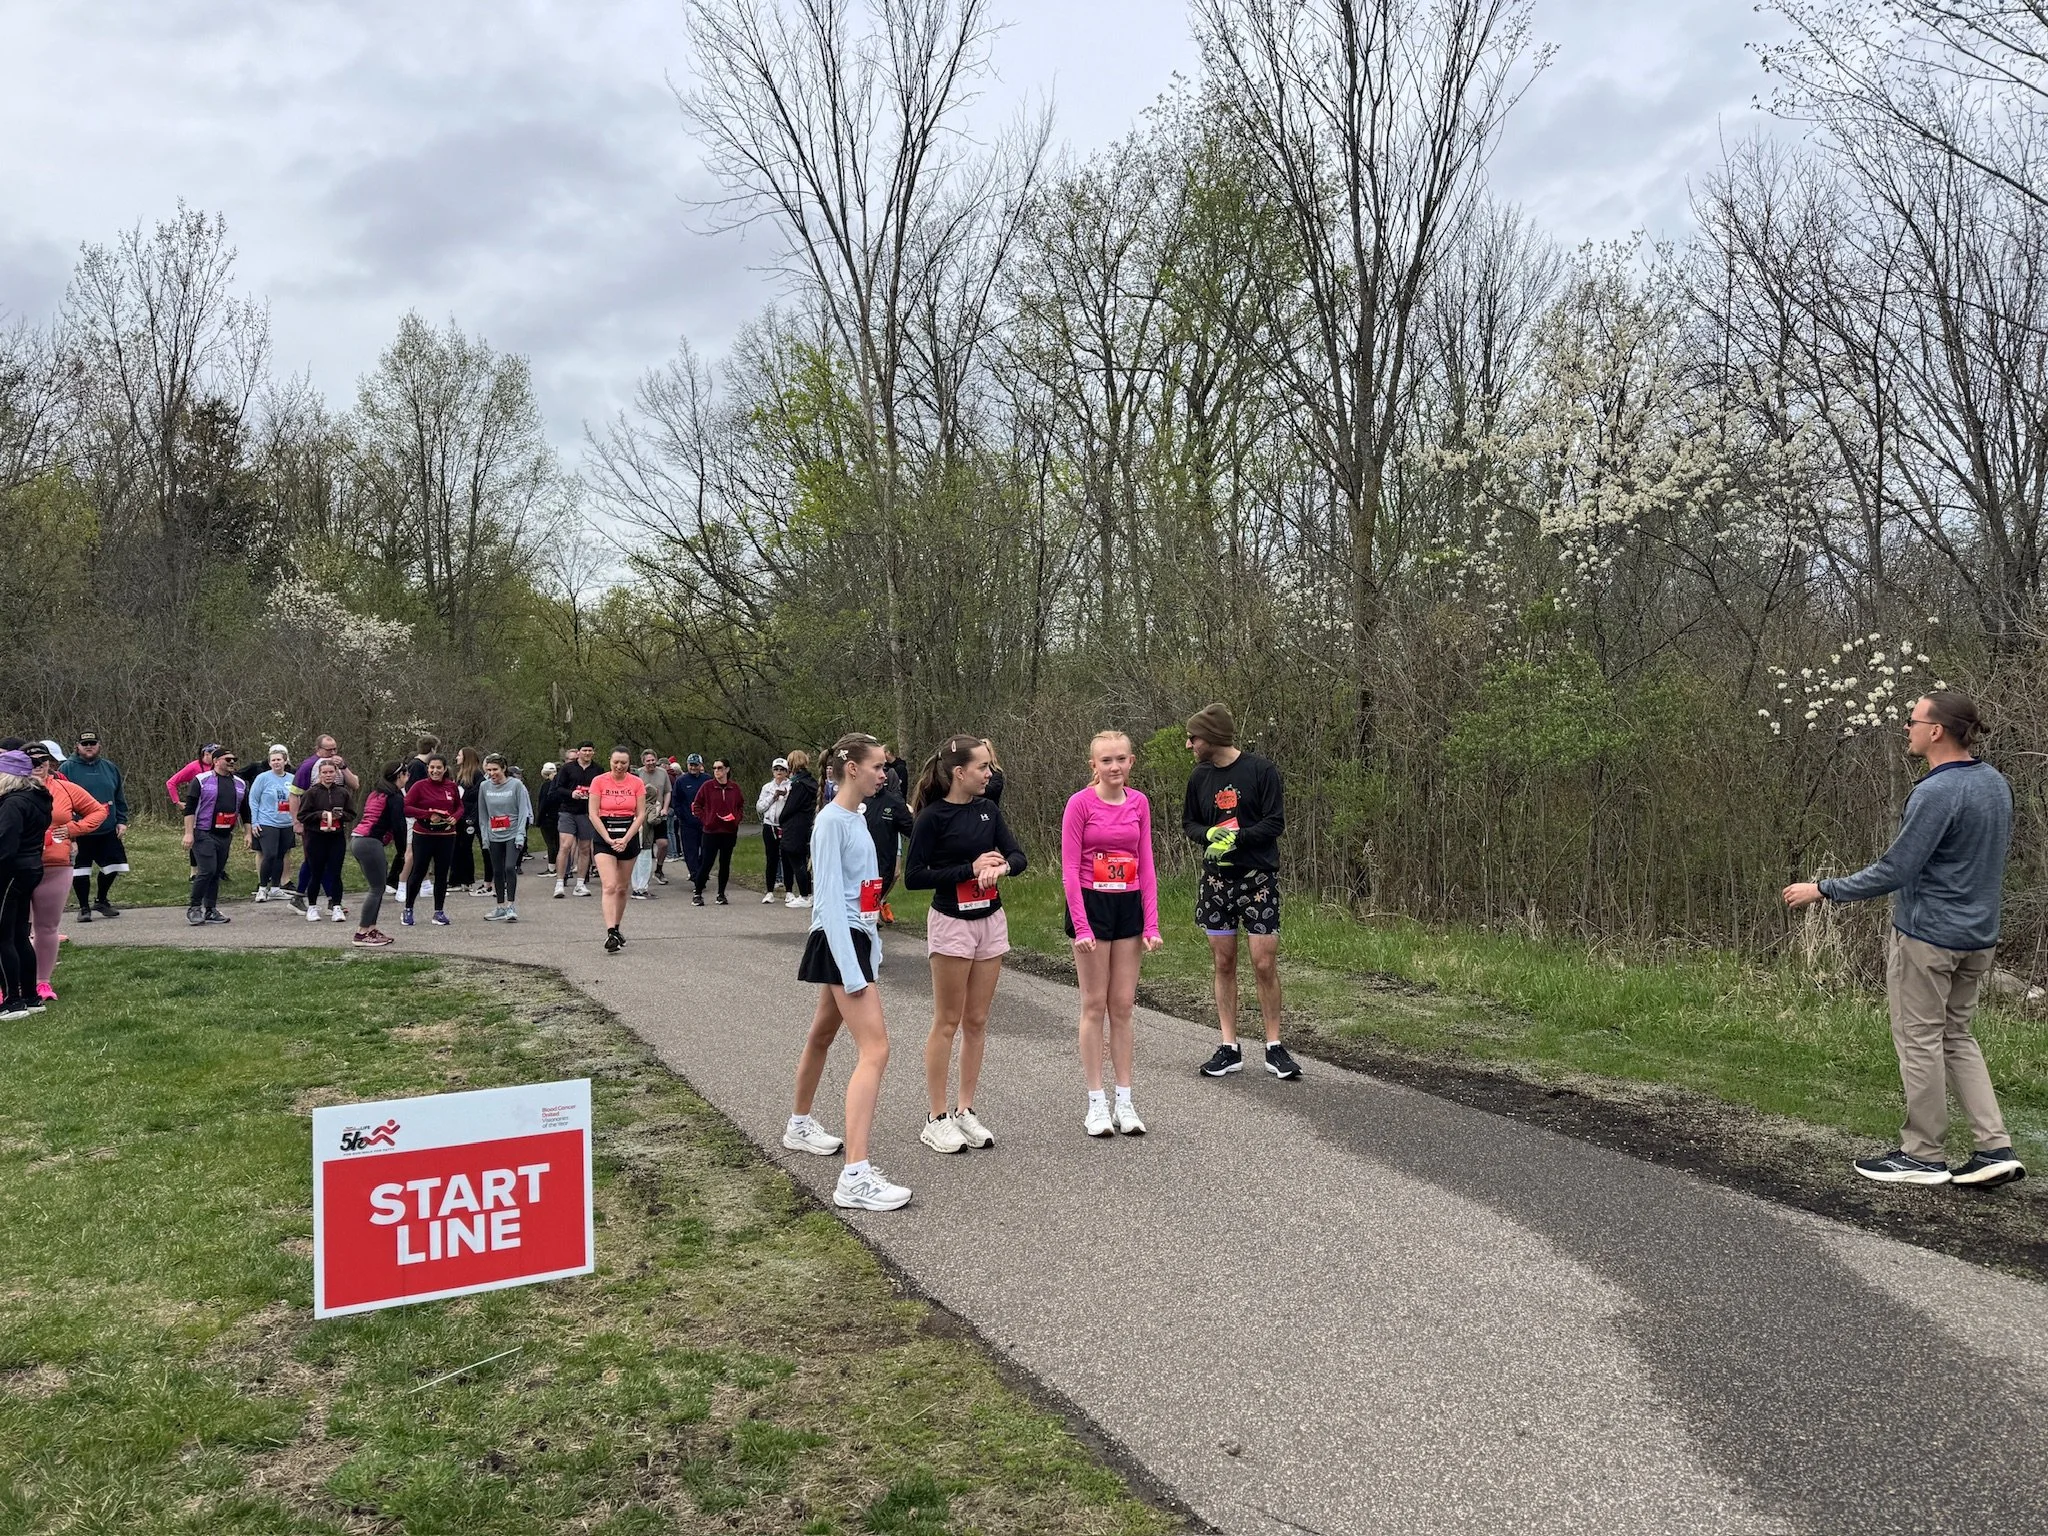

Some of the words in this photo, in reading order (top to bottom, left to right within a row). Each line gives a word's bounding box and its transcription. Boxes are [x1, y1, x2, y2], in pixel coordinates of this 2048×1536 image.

[1107, 864, 1126, 880] 34
[369, 1162, 550, 1226] START
[396, 1208, 521, 1266] LINE
